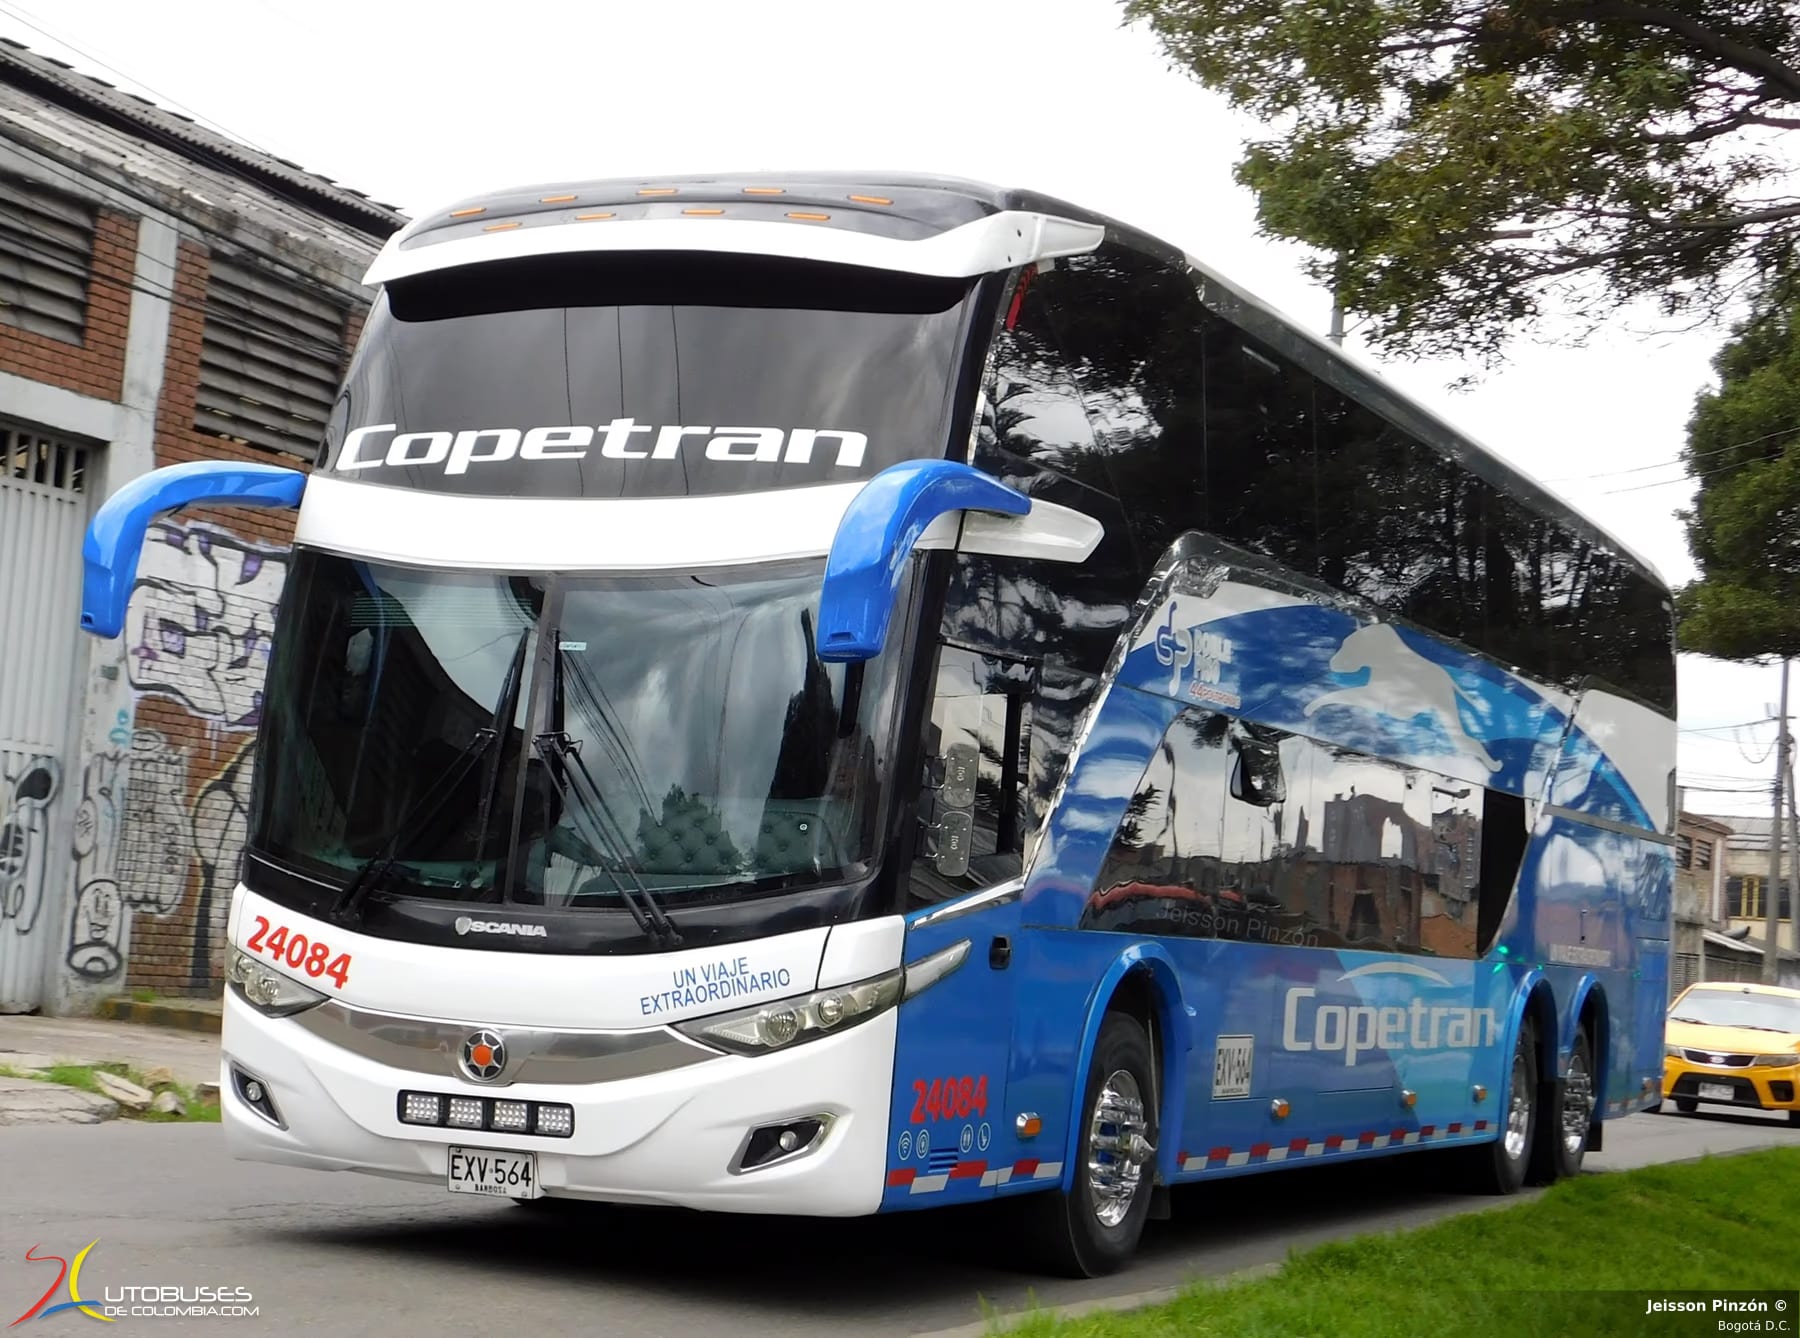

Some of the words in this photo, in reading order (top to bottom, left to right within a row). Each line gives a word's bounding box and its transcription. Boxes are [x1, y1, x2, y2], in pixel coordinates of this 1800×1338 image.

[335, 417, 868, 475] Copetran
[246, 915, 352, 990] 24084
[470, 920, 548, 937] SCANIA
[639, 968, 791, 1016] EXTRAORDINARIO
[672, 967, 697, 989] UN
[700, 956, 750, 982] VIAJE
[1282, 987, 1496, 1067] Copetran
[909, 1074, 989, 1125] 24084
